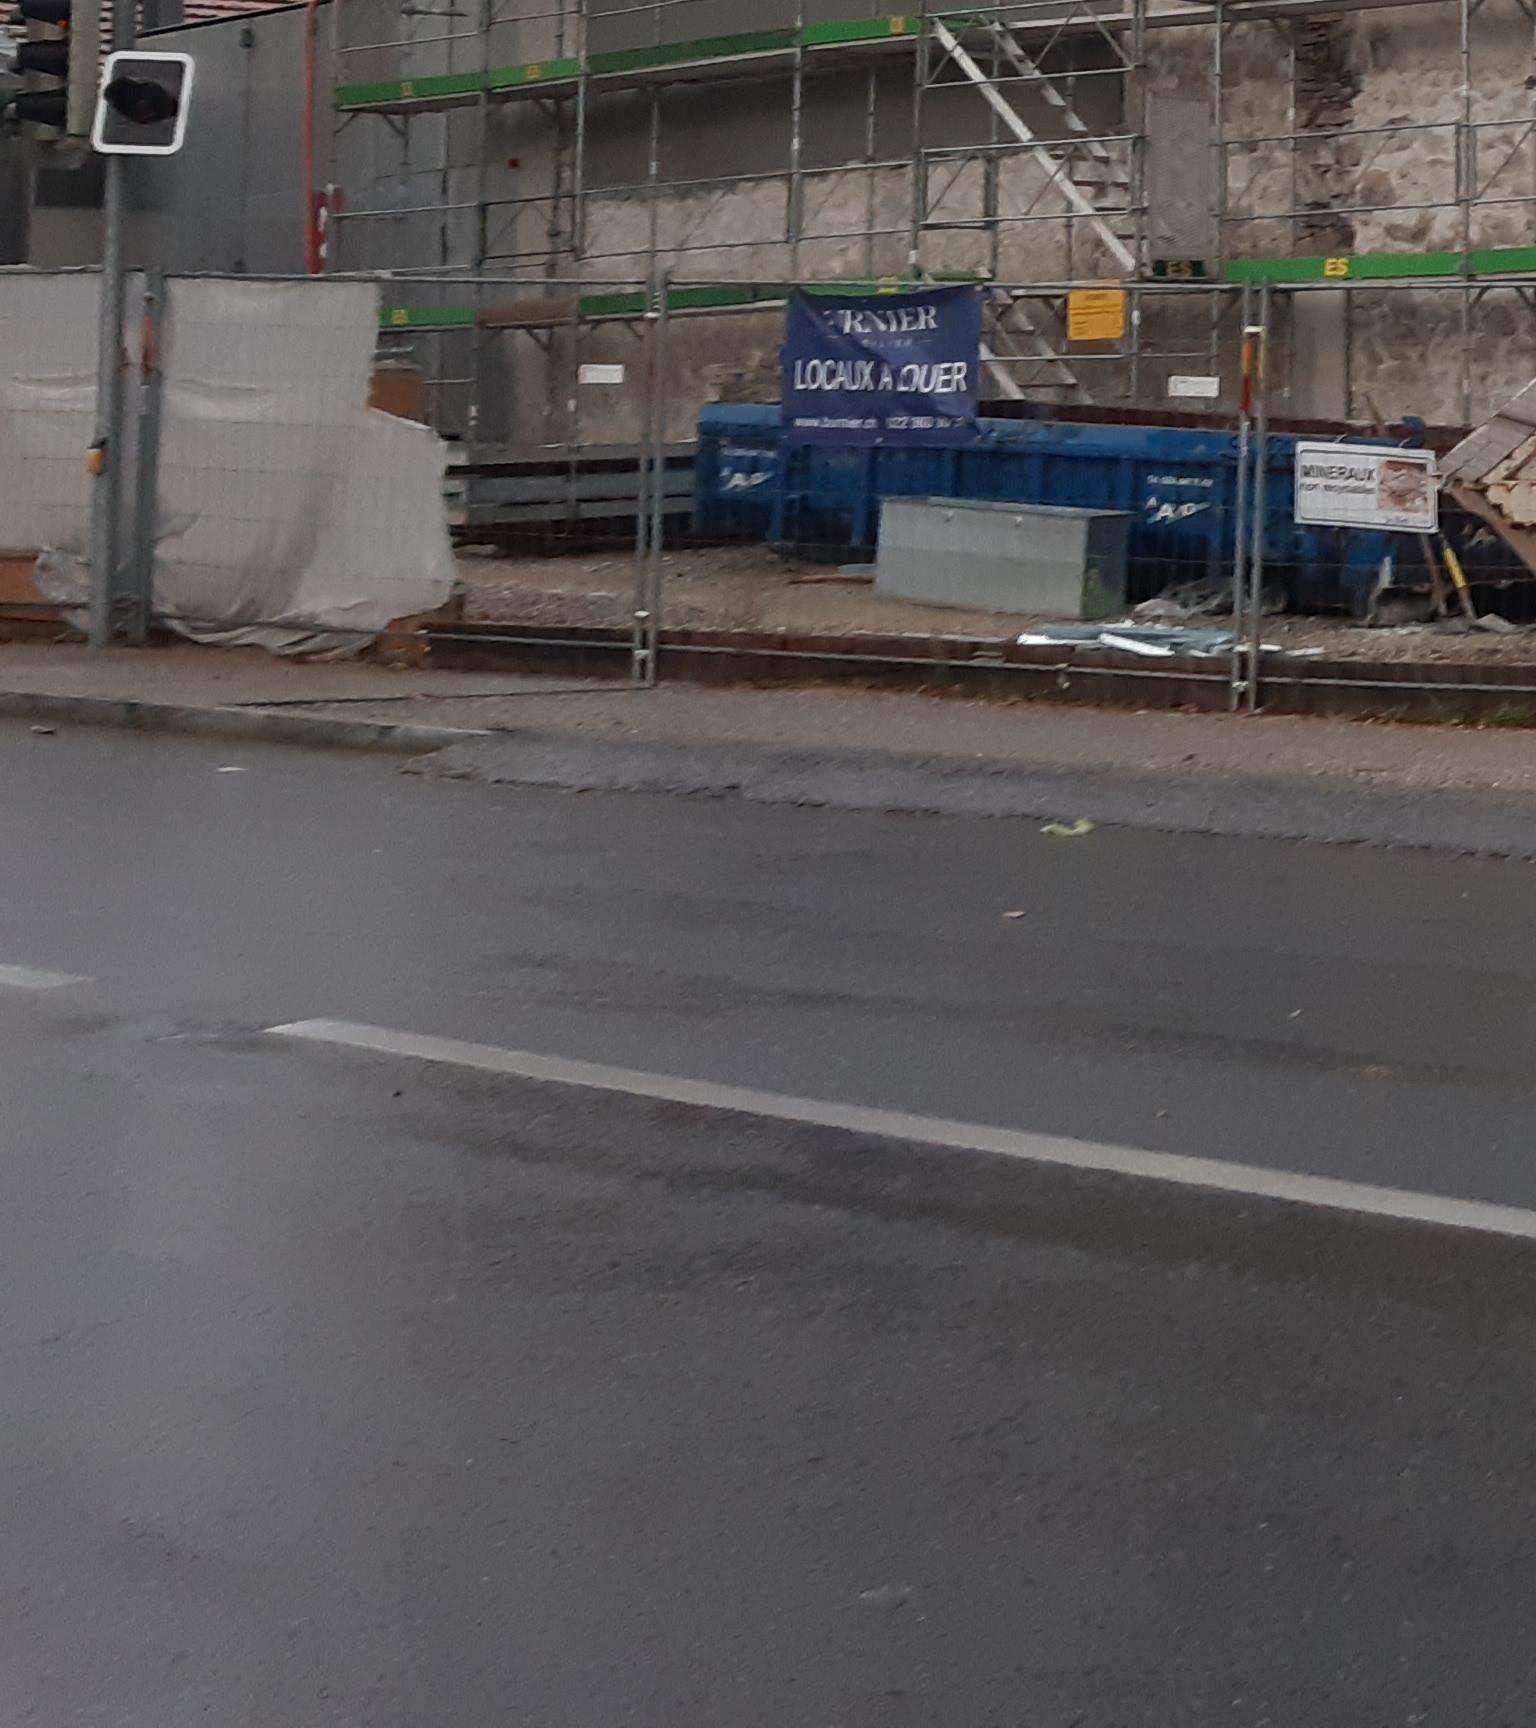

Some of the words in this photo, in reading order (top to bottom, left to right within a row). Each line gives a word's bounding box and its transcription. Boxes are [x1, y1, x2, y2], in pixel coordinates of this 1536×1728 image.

[1167, 261, 1191, 277] ES
[1325, 258, 1348, 276] ES
[824, 305, 938, 335] RNIER
[793, 358, 875, 392] LOCAUX
[1301, 464, 1377, 482] MINERAUX
